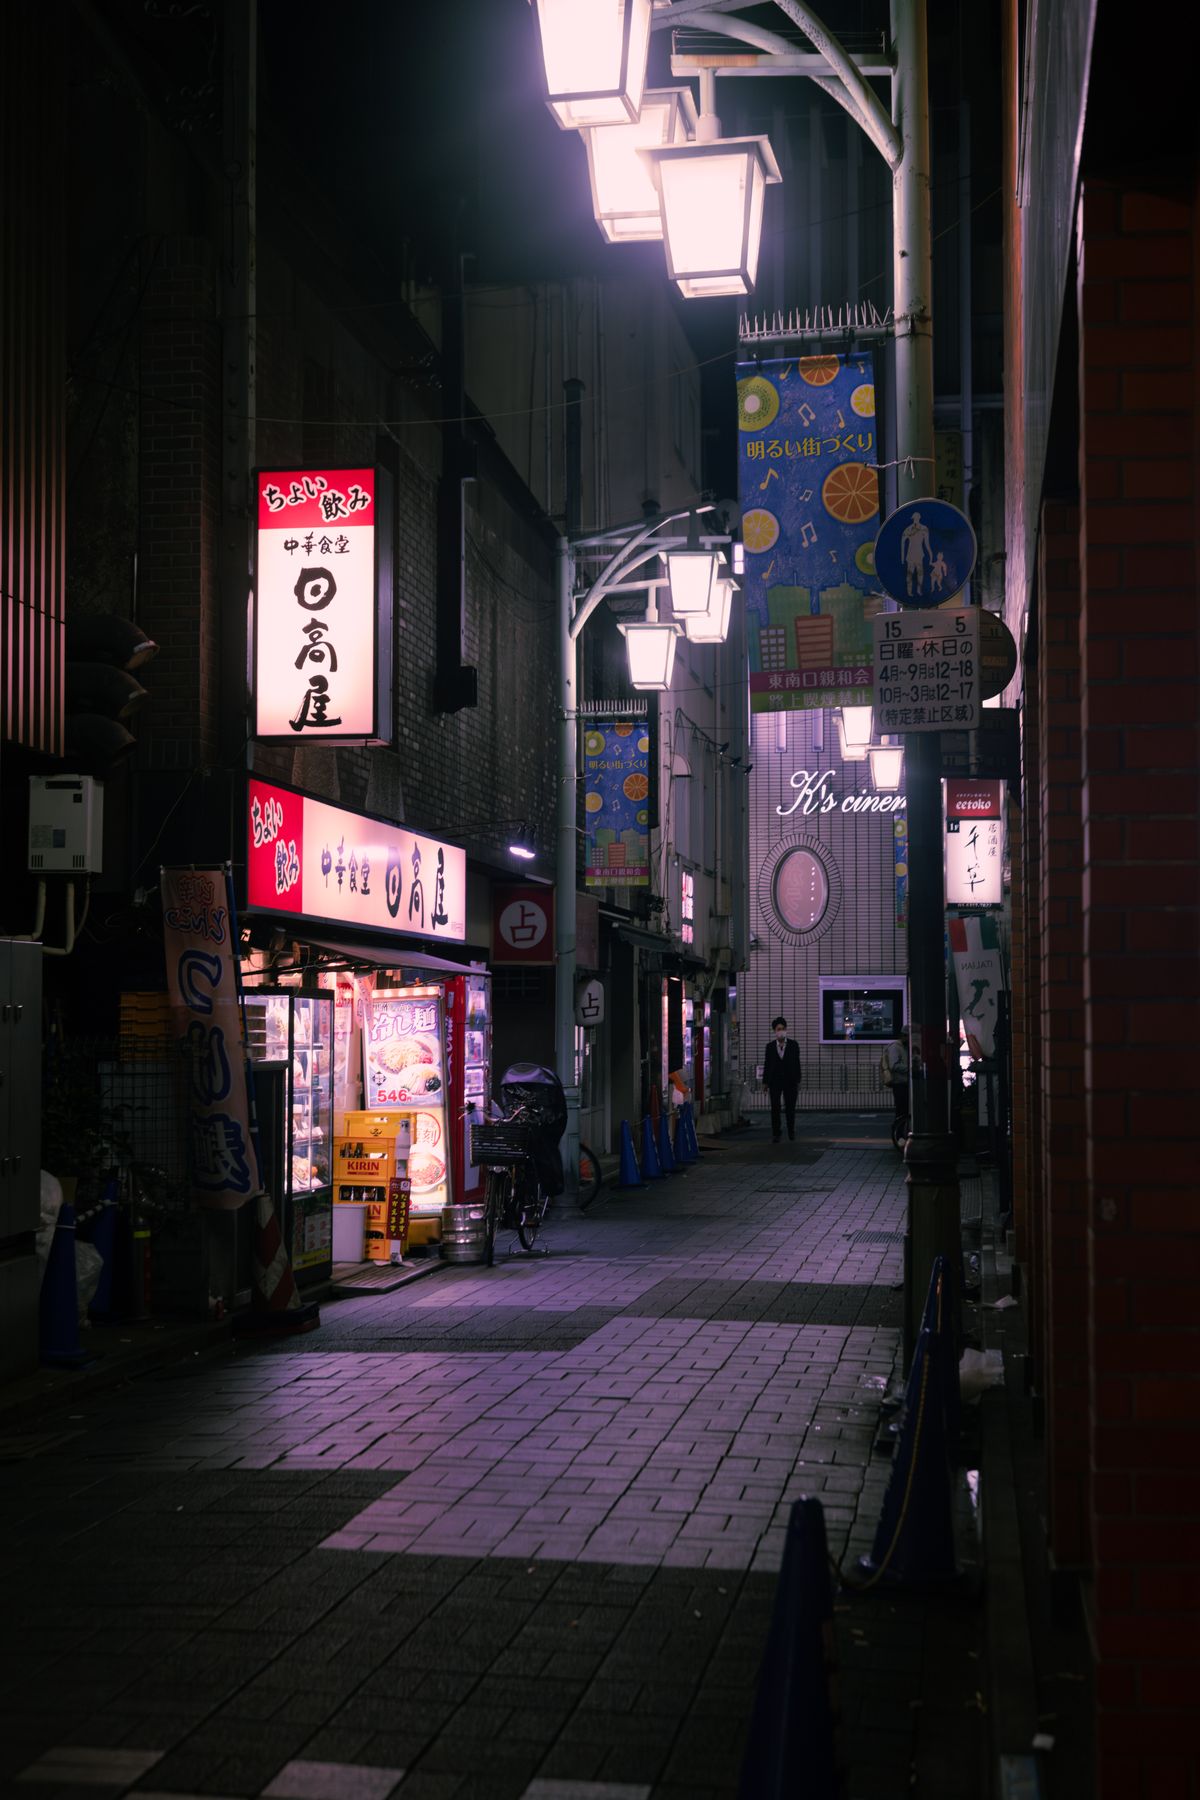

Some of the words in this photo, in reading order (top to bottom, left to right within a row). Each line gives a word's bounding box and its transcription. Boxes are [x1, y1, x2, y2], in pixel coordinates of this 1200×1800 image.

[747, 432, 873, 460] 明るい街づくり
[264, 477, 371, 520] ちょい飲み
[284, 532, 350, 555] 中華食堂
[885, 621, 901, 638] 15
[955, 616, 966, 633] 5
[289, 567, 342, 731] 日高屋
[880, 640, 973, 660] 日曜・休日の
[768, 669, 870, 689] 東南口親和会
[768, 690, 870, 710] 路上喫煙禁止
[776, 770, 837, 815] K's
[956, 798, 991, 810] eetoko
[252, 797, 283, 847] ちょい
[275, 840, 299, 894] 飲み
[321, 835, 370, 894] 中華食堂
[386, 842, 448, 929] 日高屋
[509, 904, 537, 943] 占
[371, 1003, 437, 1041] 冷し麺
[582, 993, 599, 1018] 占
[347, 1161, 379, 1170] KIRIN
